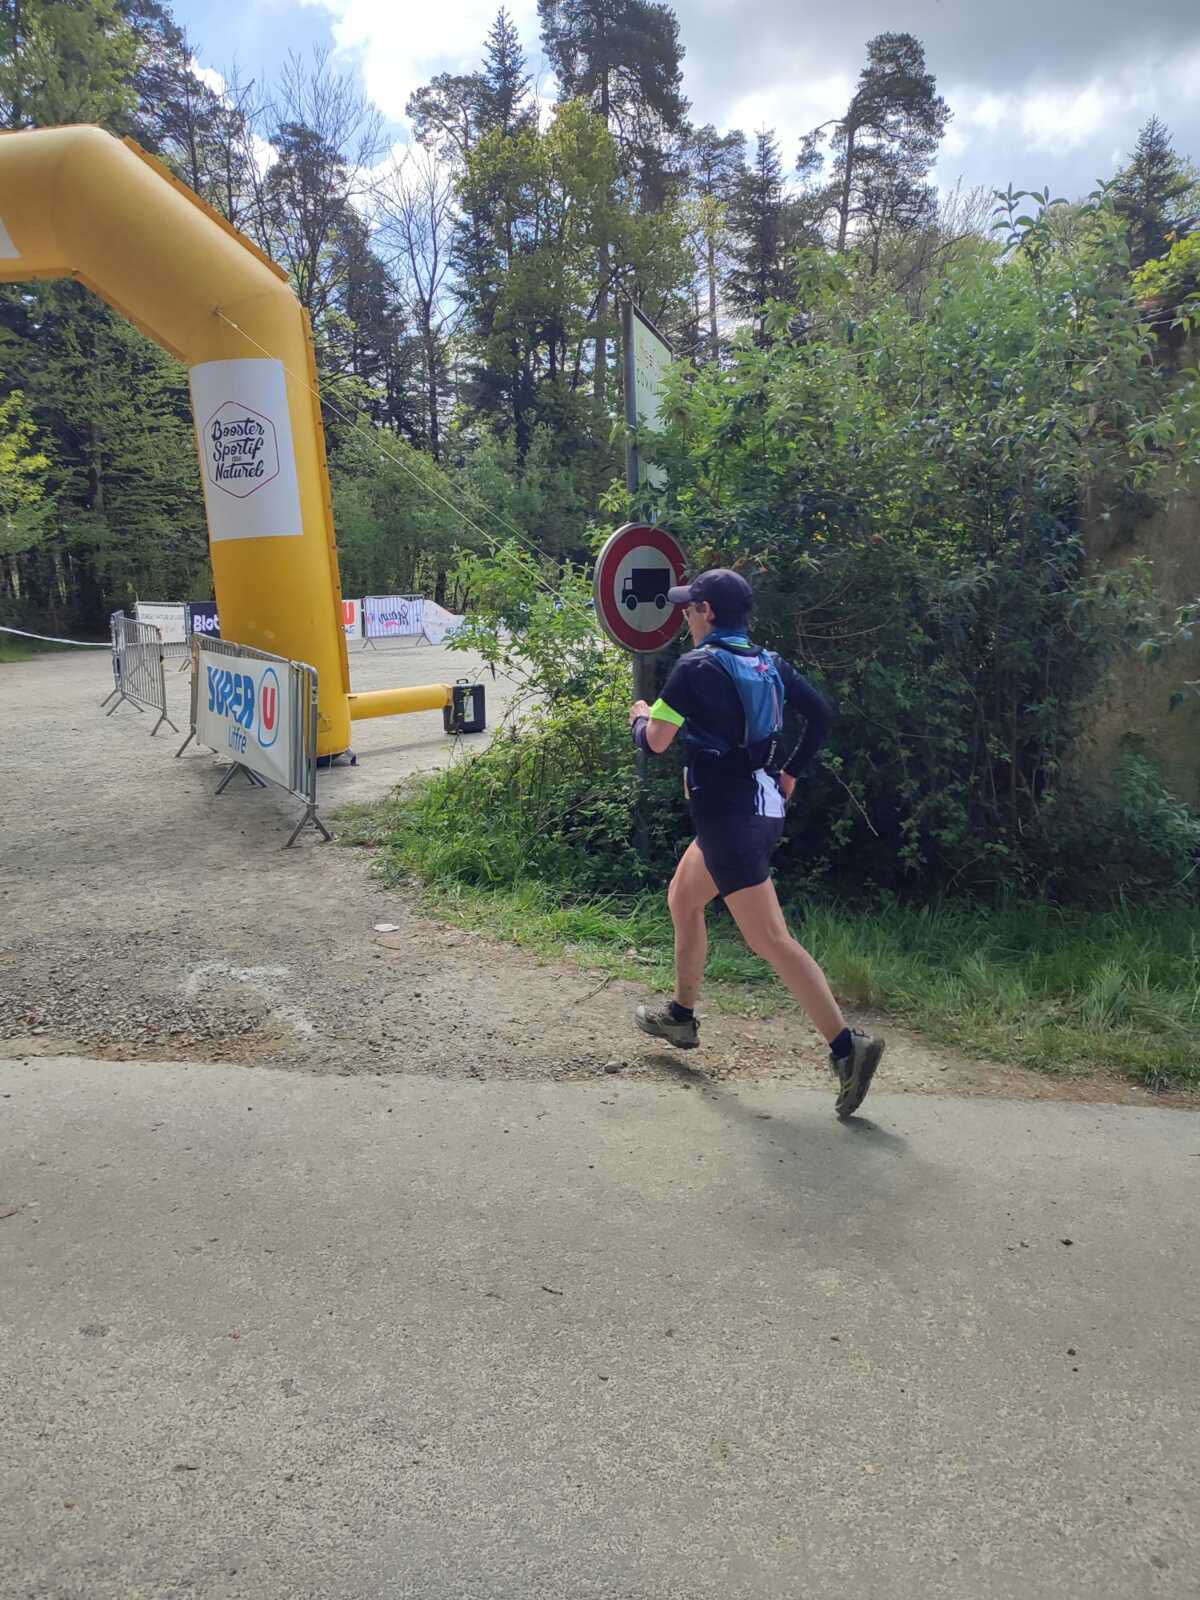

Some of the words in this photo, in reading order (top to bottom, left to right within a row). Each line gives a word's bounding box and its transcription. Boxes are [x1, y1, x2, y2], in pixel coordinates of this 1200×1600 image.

[211, 417, 265, 442] Booster
[213, 437, 264, 462] Sportif
[215, 460, 264, 482] Naturel
[207, 665, 255, 730] SUPER
[262, 686, 276, 730] U
